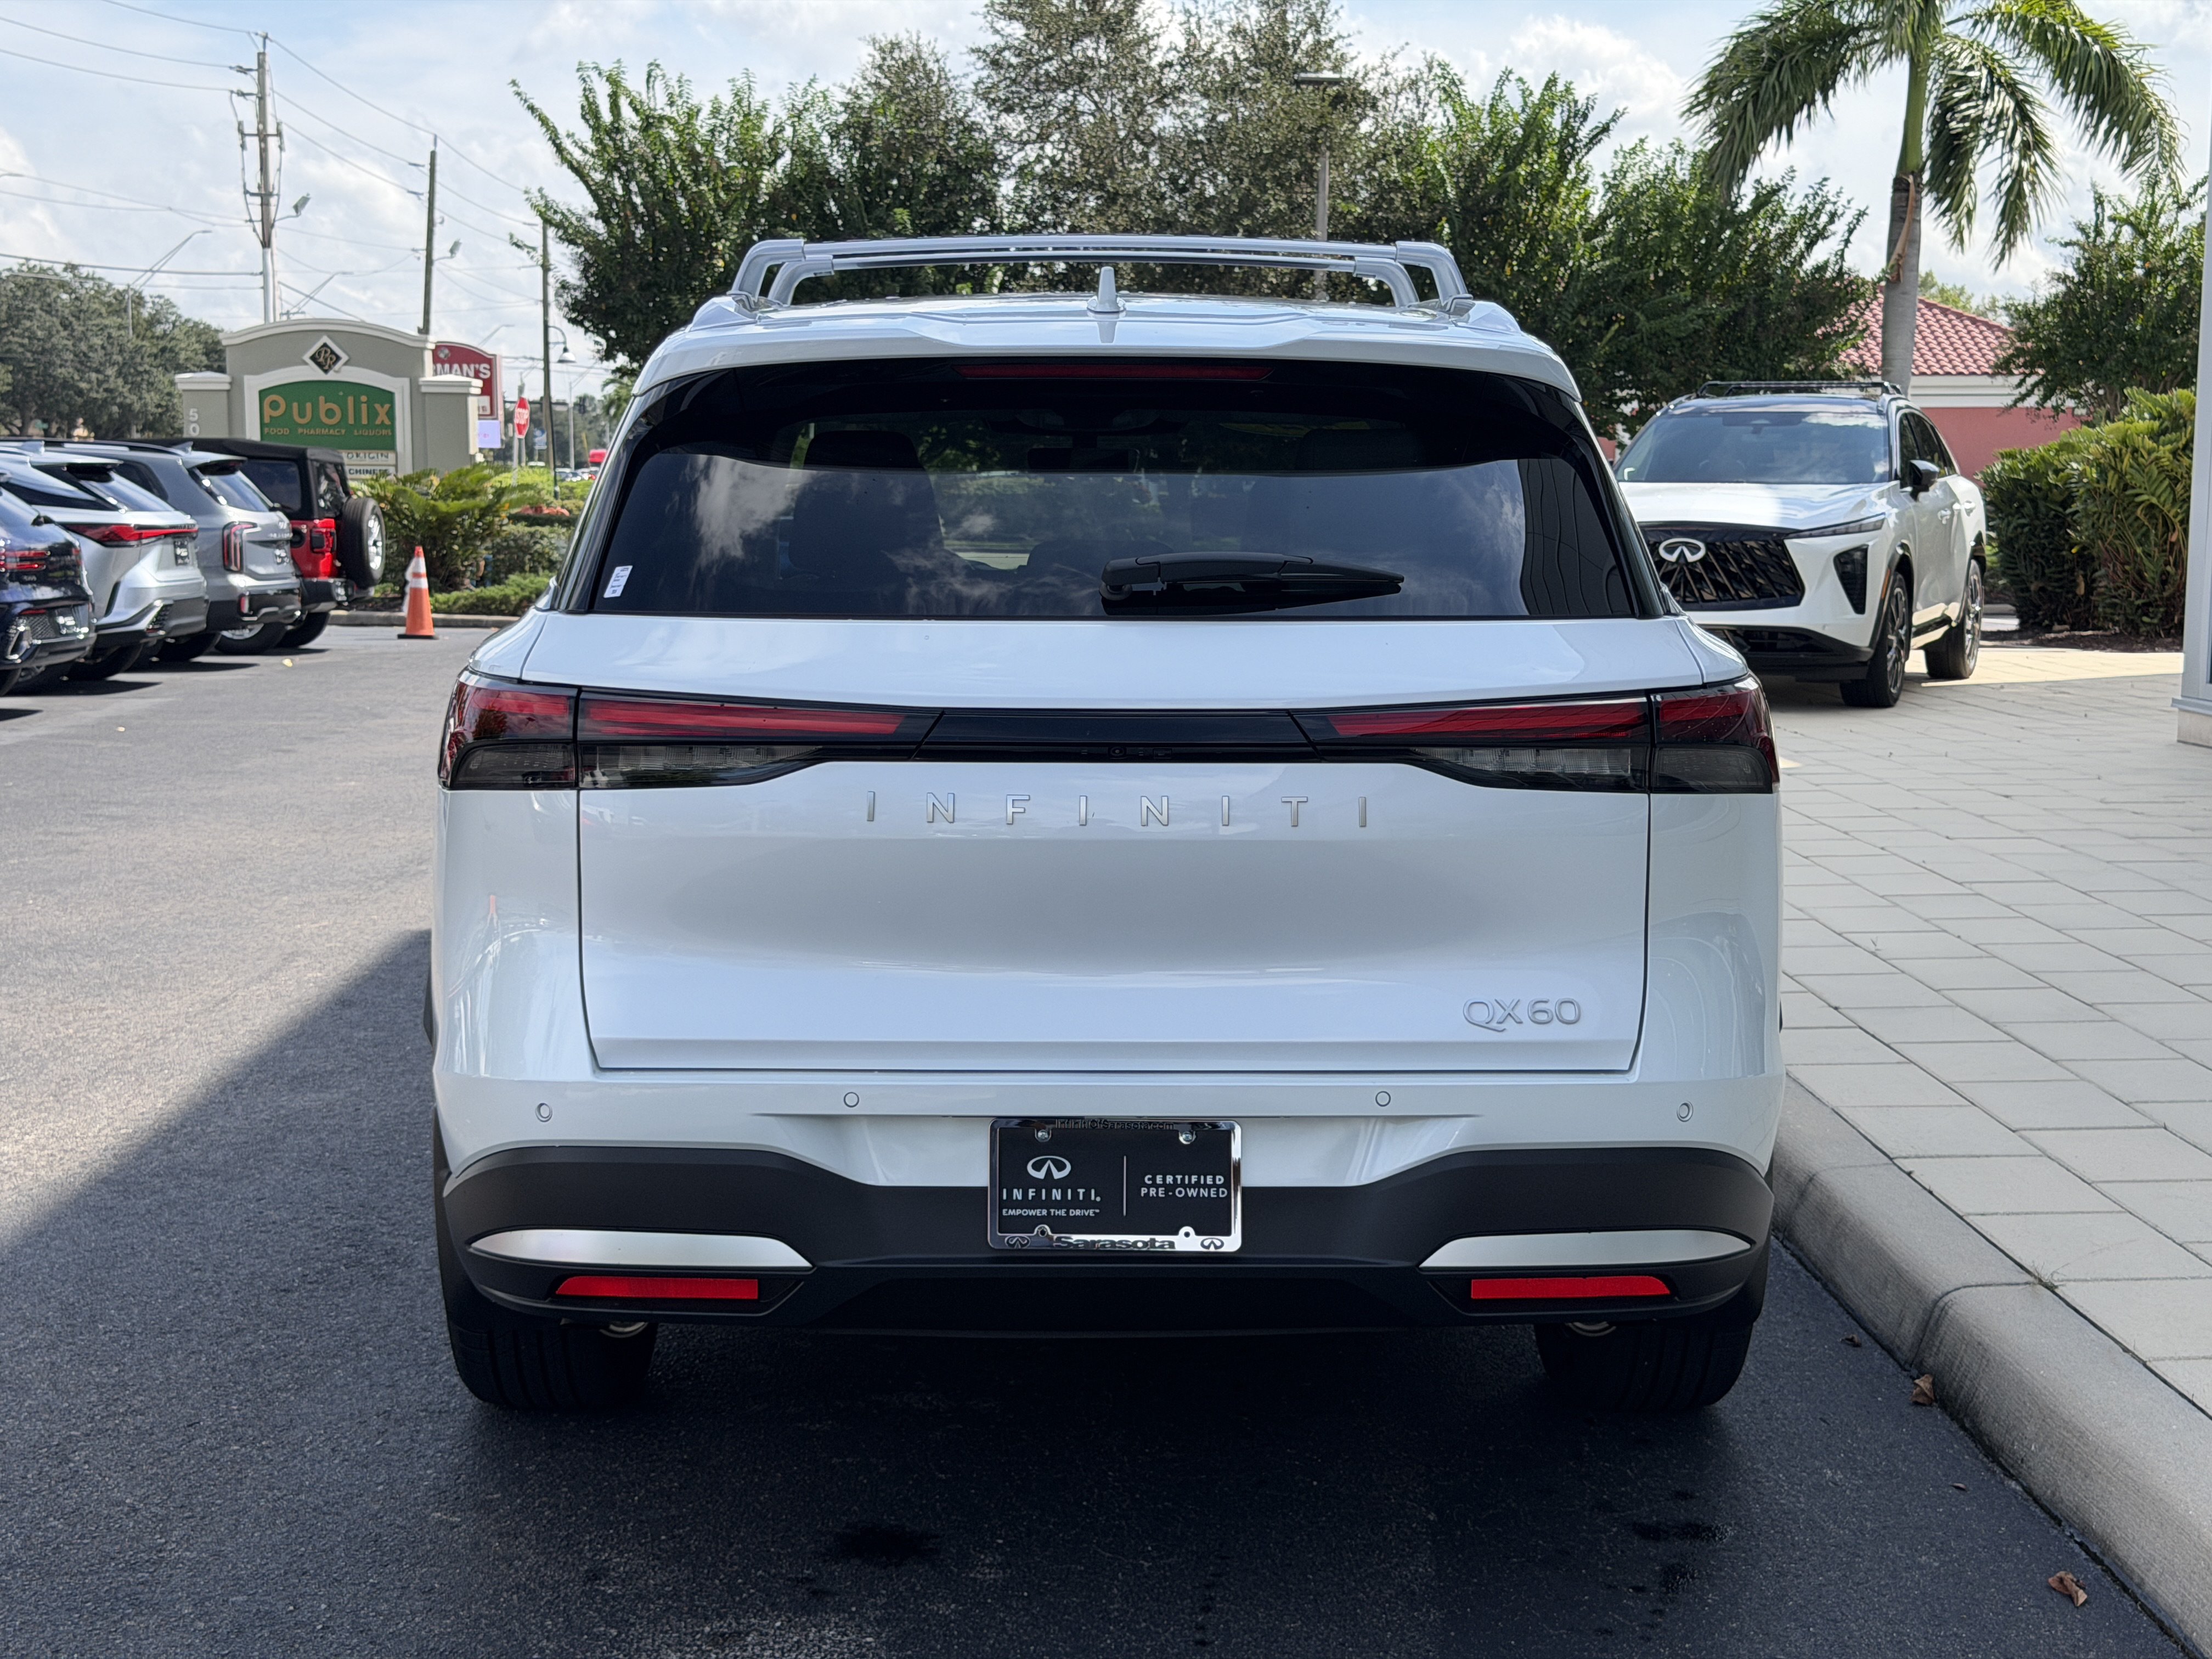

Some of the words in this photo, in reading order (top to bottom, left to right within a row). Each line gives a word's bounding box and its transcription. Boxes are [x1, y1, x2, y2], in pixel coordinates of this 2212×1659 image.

[432, 363, 491, 379] MAN'S
[264, 394, 392, 425] Publix
[866, 791, 1367, 827] INFINITI
[1463, 997, 1581, 1032] QX60
[1144, 1175, 1224, 1184] CERTIFIED
[1141, 1187, 1228, 1198] PRE-OWNED
[1053, 1236, 1176, 1250] Sarasota
